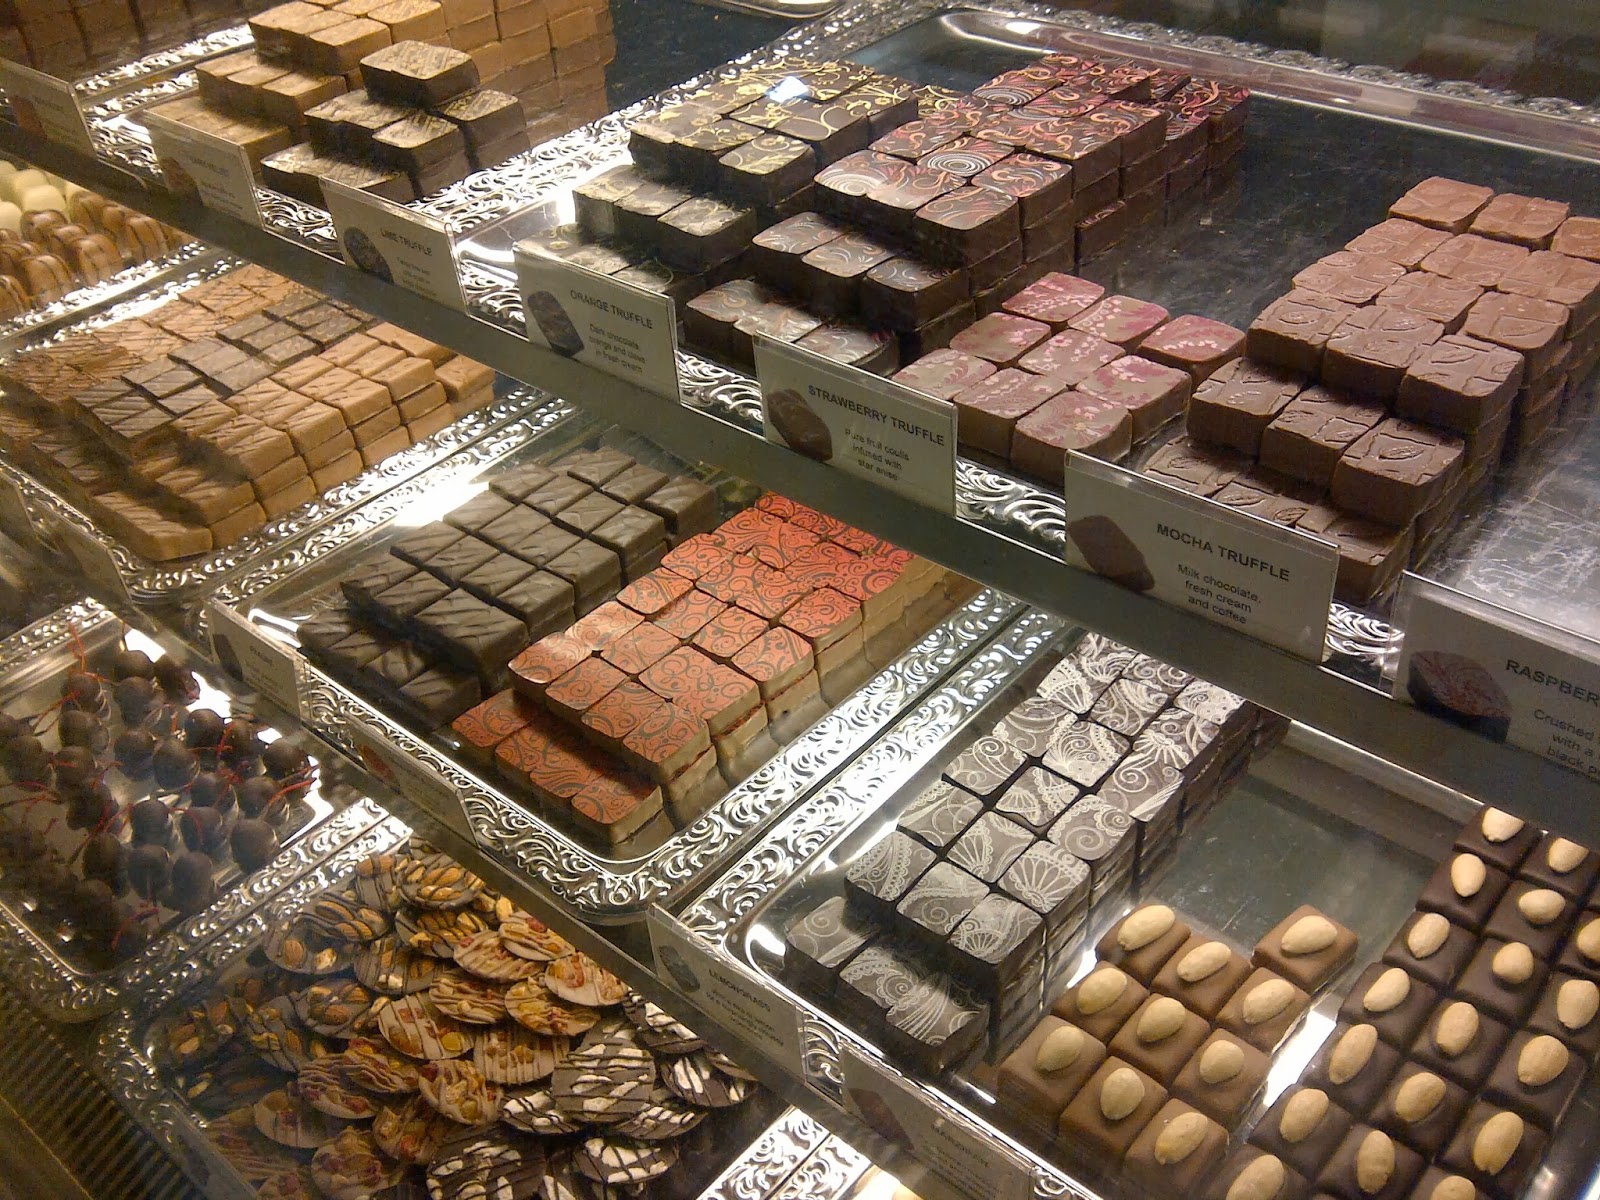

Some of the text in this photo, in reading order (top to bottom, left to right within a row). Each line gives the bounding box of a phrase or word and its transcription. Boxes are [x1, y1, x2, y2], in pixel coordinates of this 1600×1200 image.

[399, 235, 433, 257] TRUFFLE
[570, 289, 653, 329] ORANGE TRUFFLE
[808, 385, 945, 447] STRAWBERRY TRUFFLE
[844, 428, 910, 461] Pure fruit coulis
[853, 444, 902, 471] infused with
[858, 459, 898, 481] star anise
[1156, 523, 1291, 582] MOCHA TRUFFLE
[1177, 563, 1261, 604] Milk chocolate,
[1185, 580, 1252, 613] fresh cream
[1188, 595, 1247, 624] and coffee
[1506, 659, 1600, 708] RASPBER
[1534, 709, 1595, 741] Crushed
[1546, 744, 1585, 768] black
[1552, 733, 1594, 757] with a
